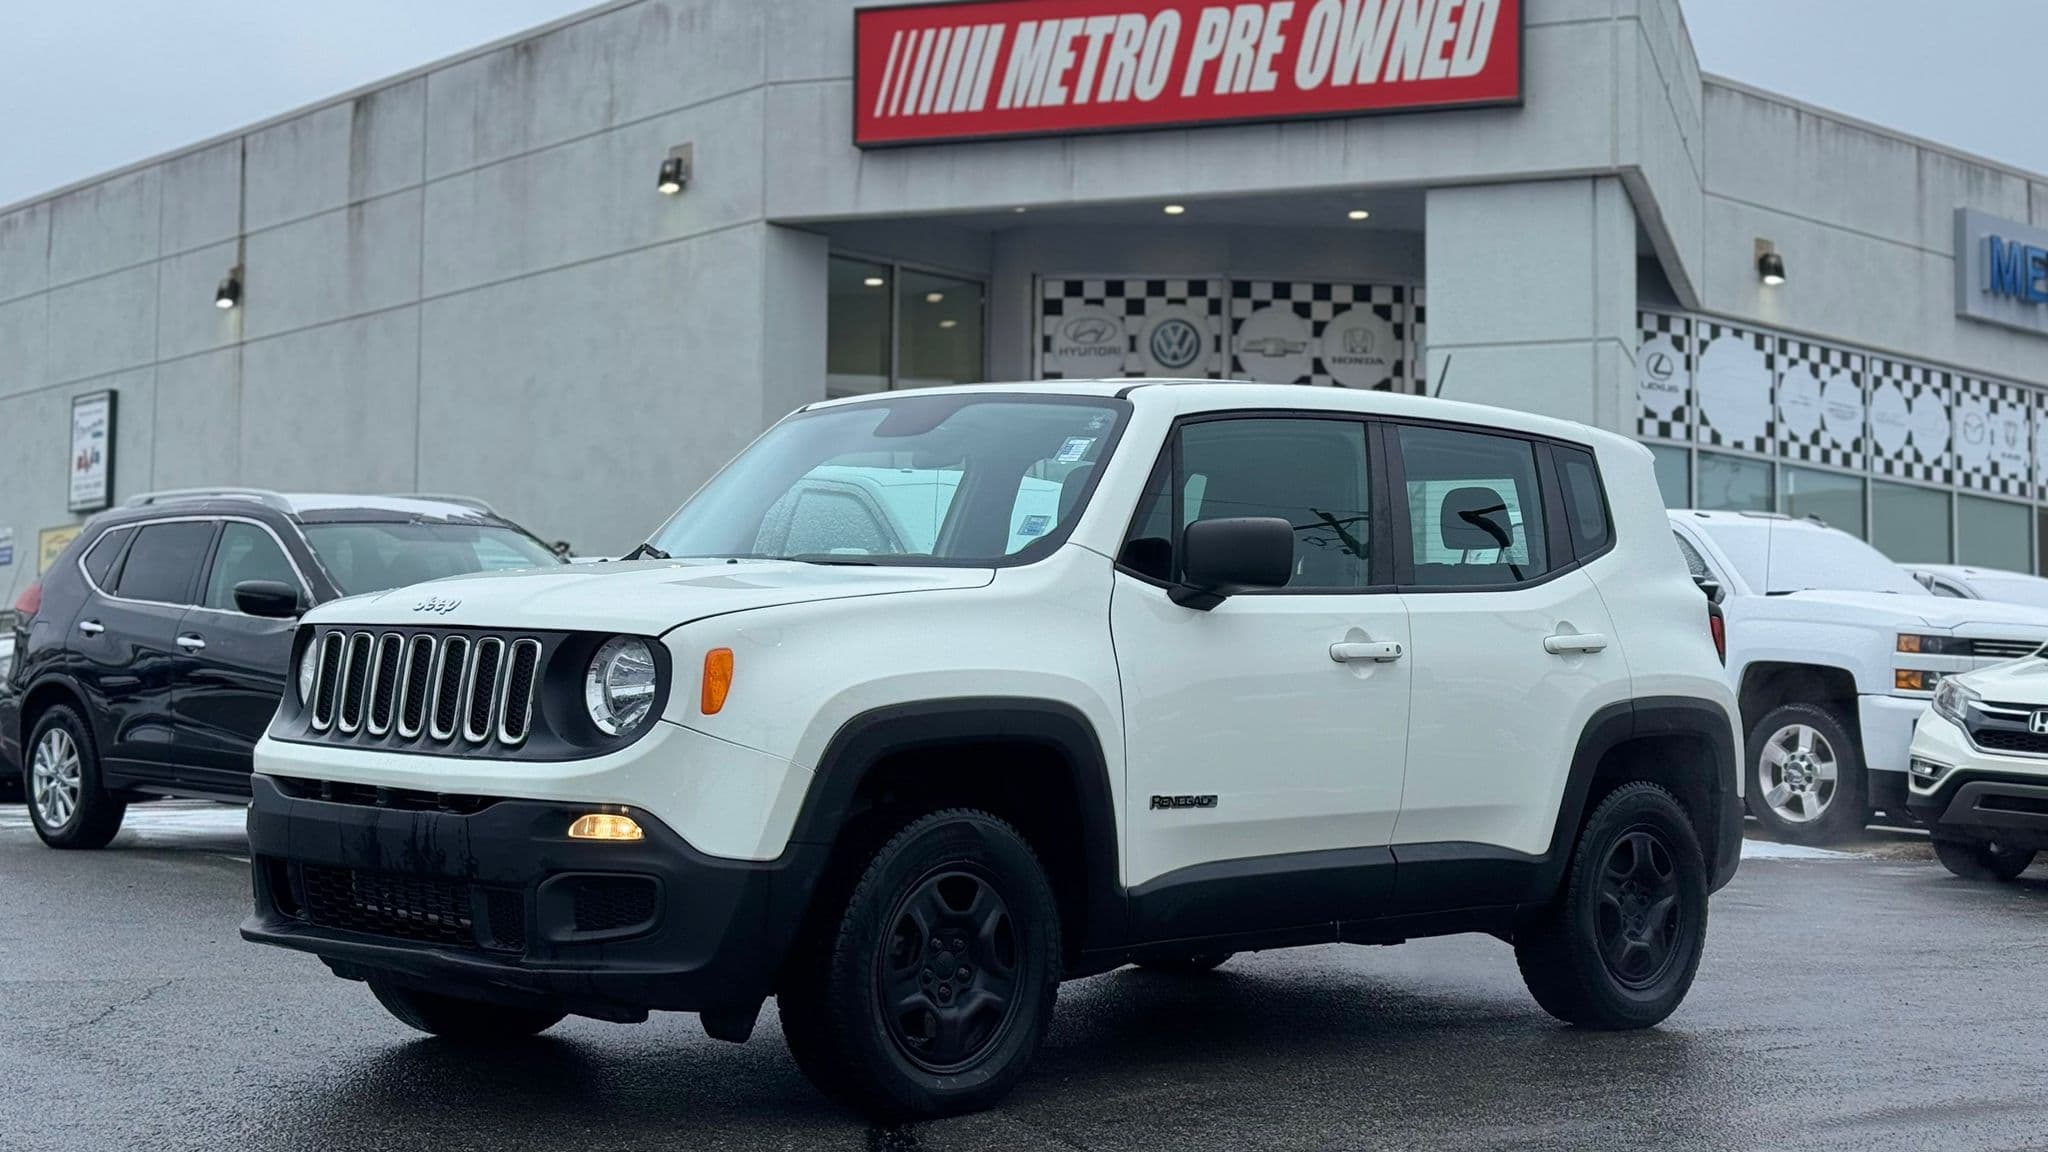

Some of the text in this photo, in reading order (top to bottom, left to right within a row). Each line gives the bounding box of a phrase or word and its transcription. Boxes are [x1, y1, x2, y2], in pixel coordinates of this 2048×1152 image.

[996, 0, 1501, 110] METRO PRE OWNED
[1058, 345, 1122, 358] HYUNDAI
[1331, 355, 1386, 366] HONDA
[411, 596, 463, 616] Jeep
